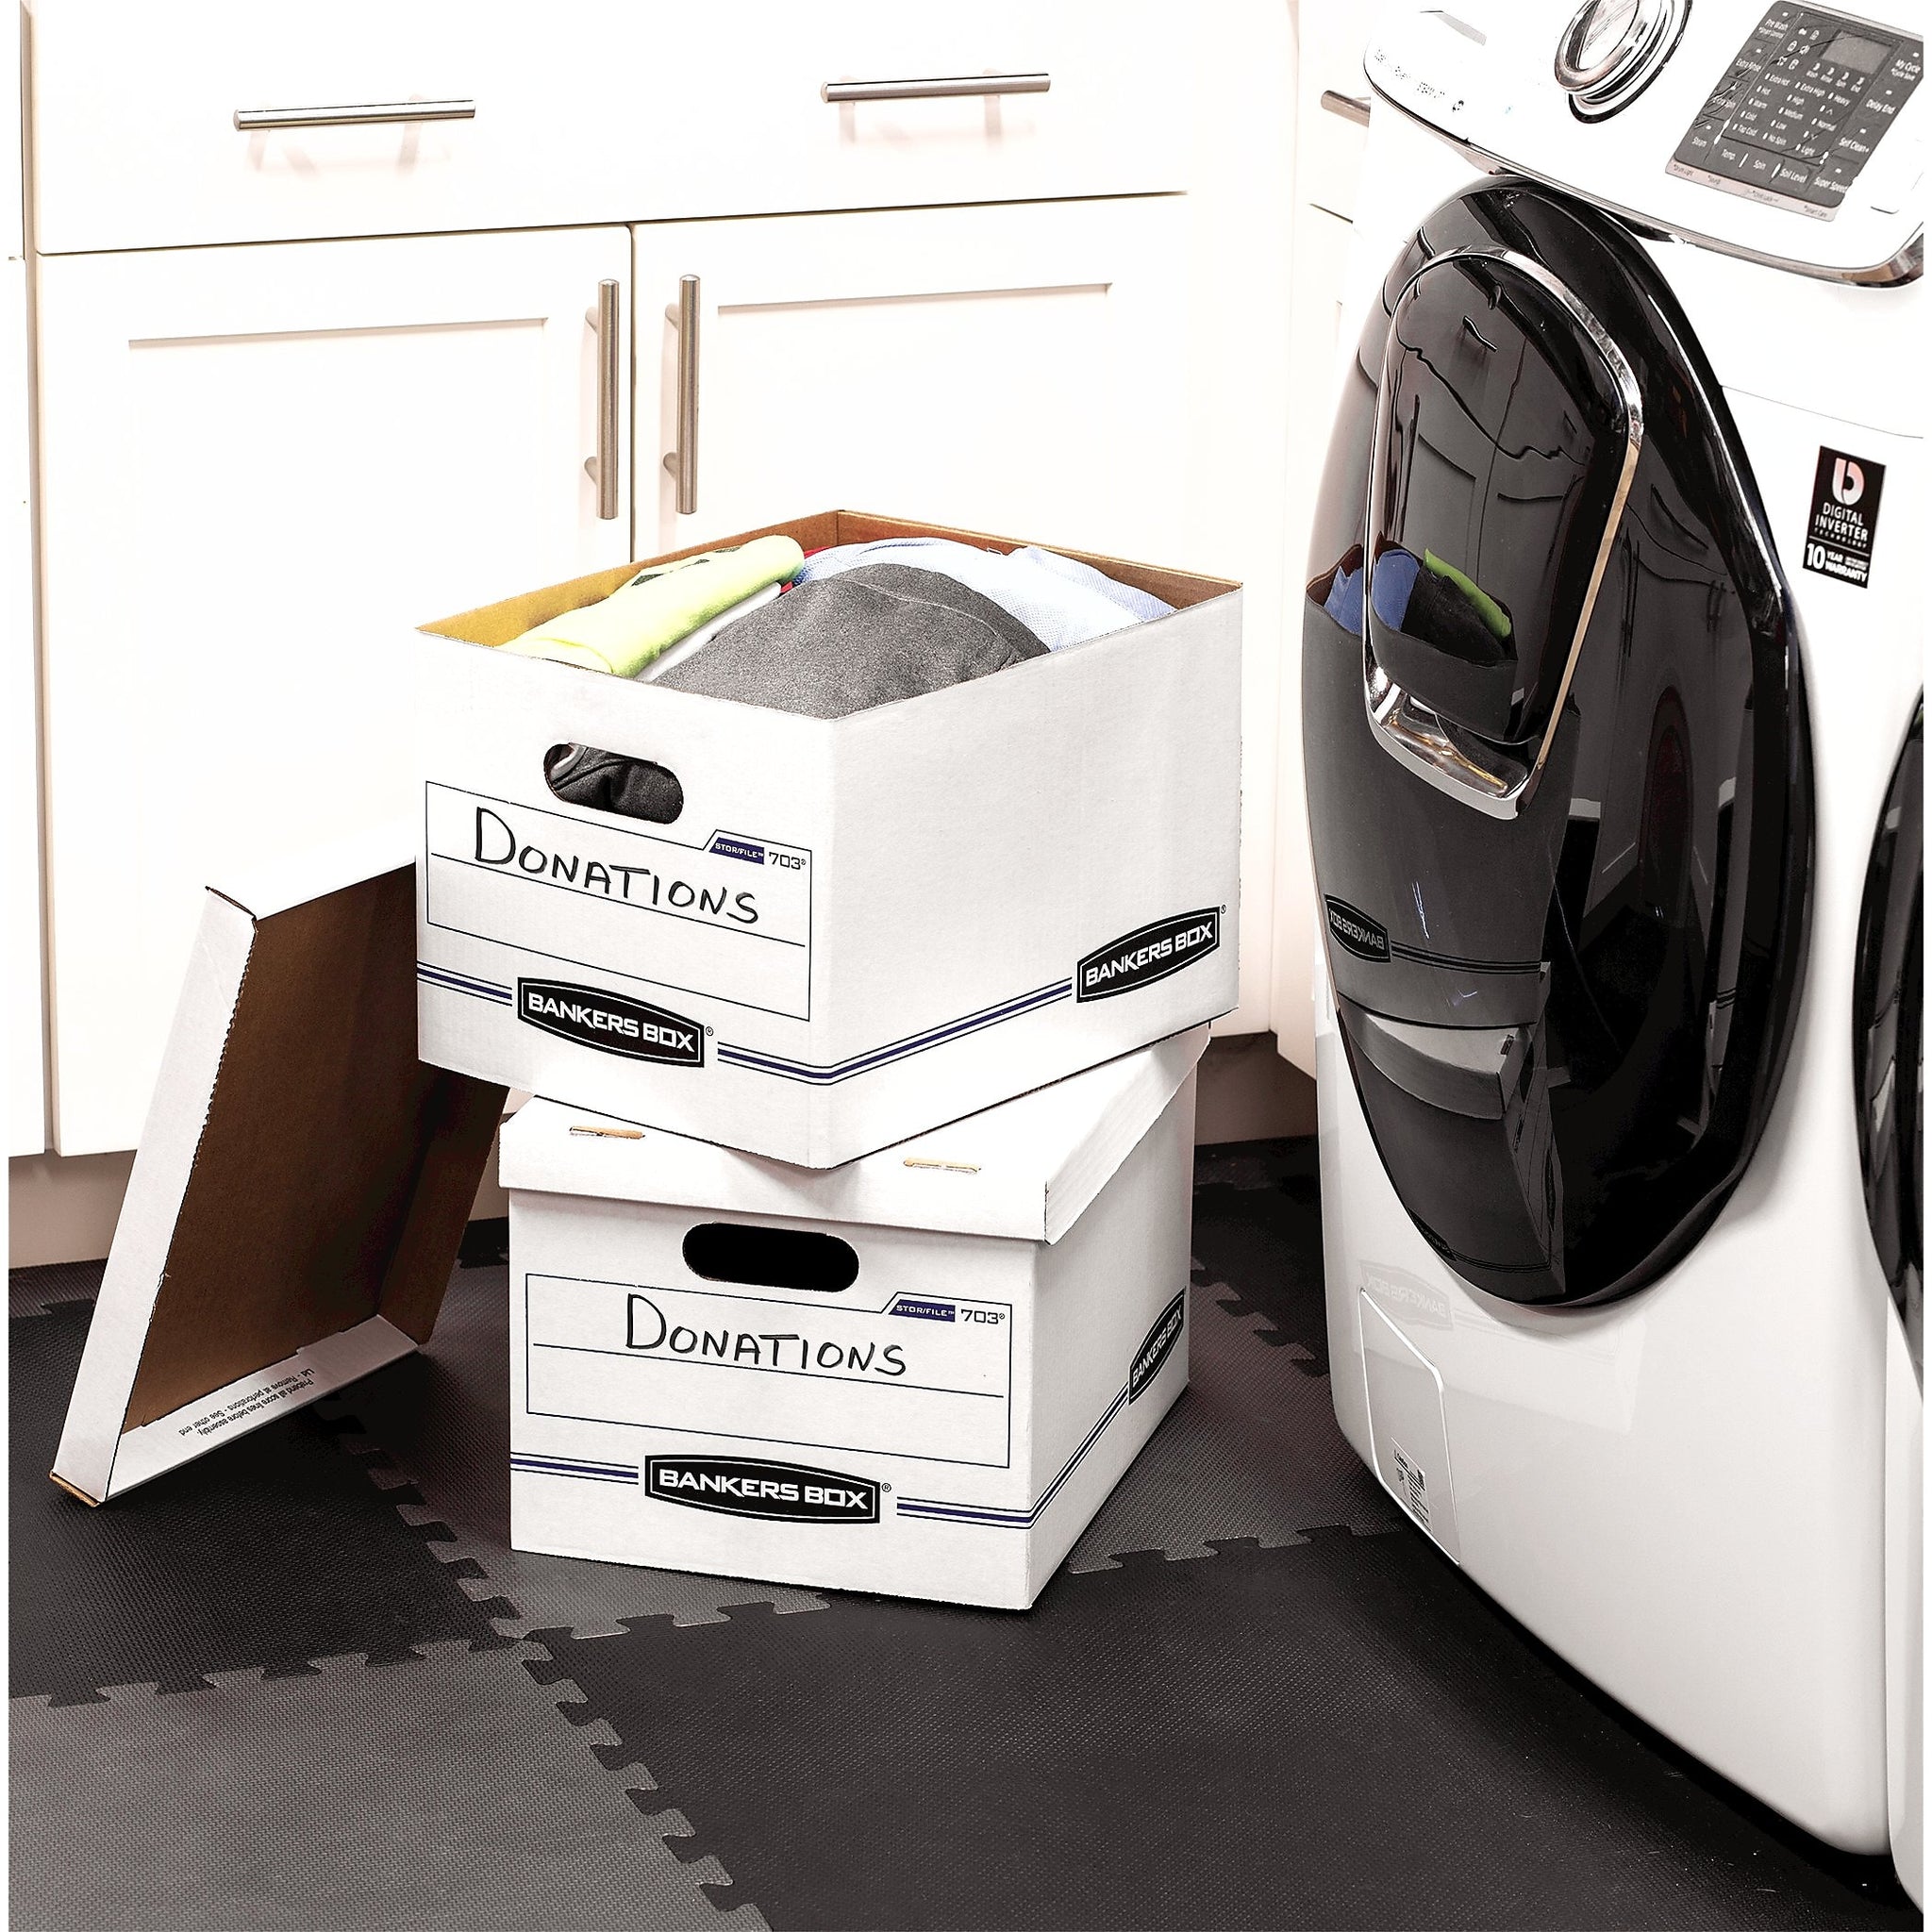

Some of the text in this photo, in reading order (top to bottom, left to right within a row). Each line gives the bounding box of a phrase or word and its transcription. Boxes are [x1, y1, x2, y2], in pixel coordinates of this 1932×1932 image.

[1736, 58, 1749, 68] Extra
[1895, 59, 1921, 74] My Cycle
[1769, 75, 1781, 84] Extra
[1800, 83, 1825, 97] Extra High
[1792, 95, 1805, 106] High
[1866, 99, 1896, 114] Delay End
[1745, 112, 1757, 121] Cold
[1784, 108, 1804, 120] Medium
[1775, 122, 1787, 130] Low
[1817, 120, 1837, 131] Normal
[1691, 137, 1707, 147] Steam
[1774, 136, 1787, 145] Spin
[1839, 137, 1853, 147] Self
[1801, 145, 1816, 156] Light
[1753, 159, 1766, 170] Spin
[1779, 168, 1808, 183] Soil Level
[1813, 176, 1832, 188] Super
[1823, 502, 1864, 526] DIGITAL
[1815, 514, 1869, 541] INVERTER
[1807, 542, 1826, 570] 10
[1826, 550, 1843, 562] YEAR
[1824, 560, 1868, 582] WARRANTY
[1086, 937, 1173, 987] BANKERS
[528, 991, 640, 1038] BANKERS
[1132, 1326, 1167, 1388] BANKERS
[271, 1377, 298, 1389] Remove
[227, 1390, 264, 1410] perforations
[209, 1410, 225, 1419] See
[228, 1407, 249, 1421] before
[193, 1417, 210, 1428] other
[178, 1426, 192, 1436] end
[658, 1468, 800, 1502] BANKERS
